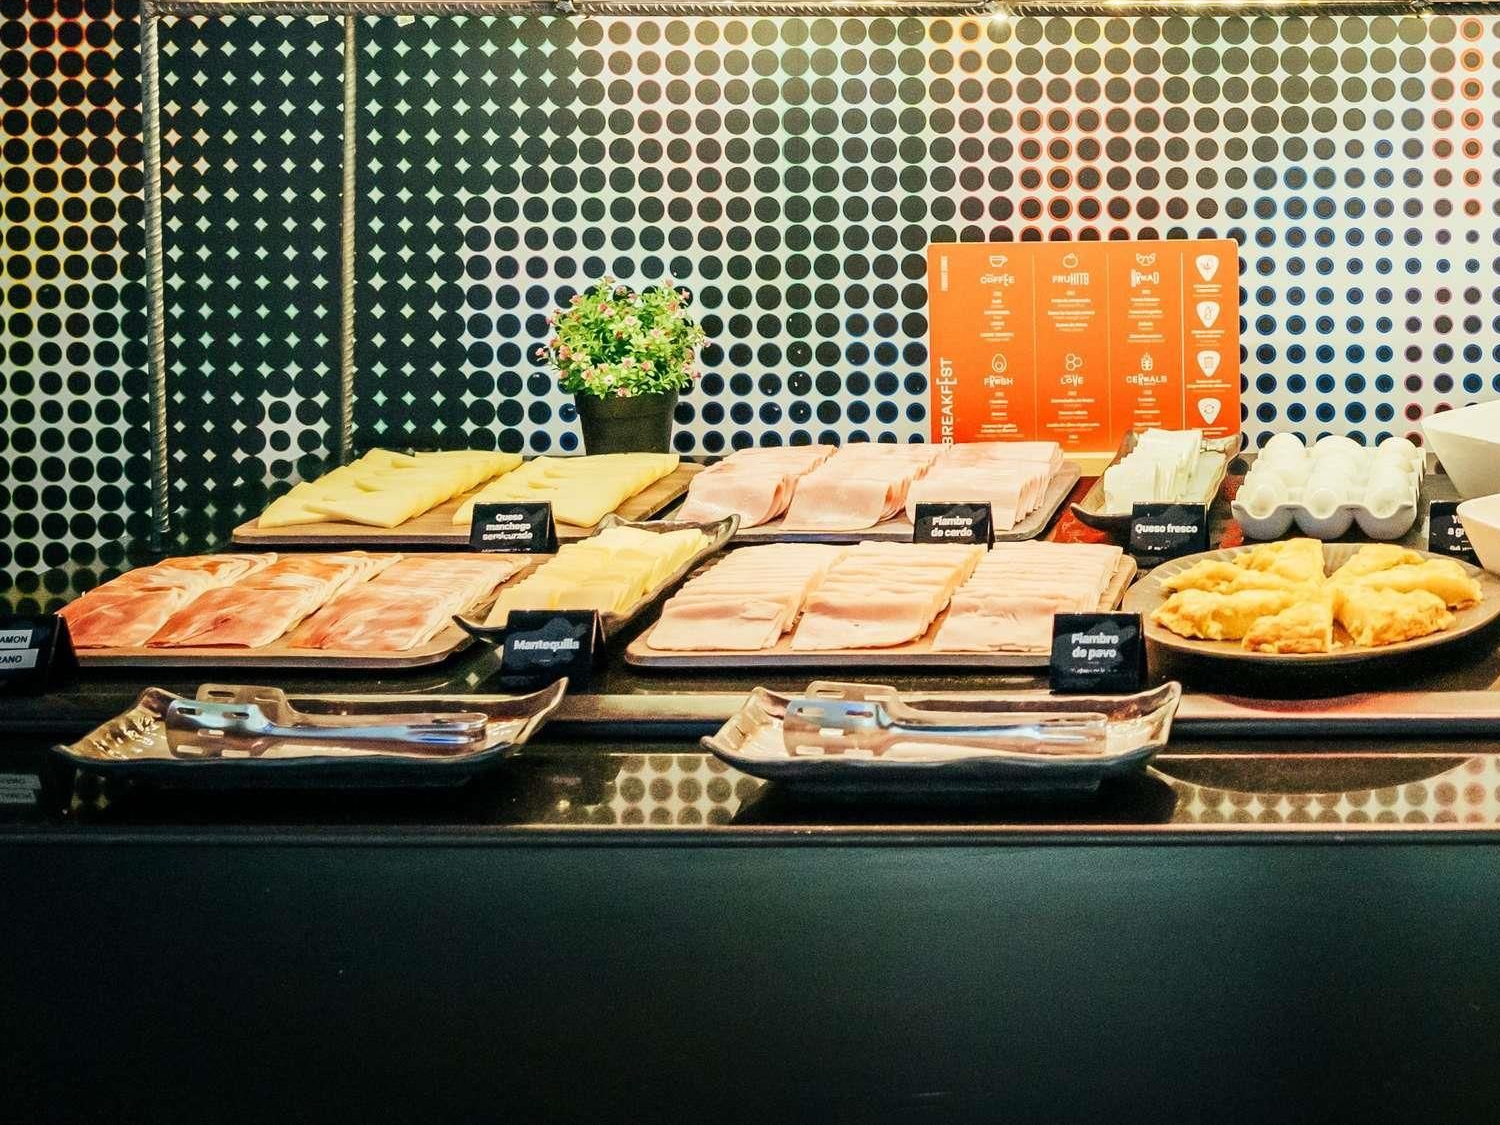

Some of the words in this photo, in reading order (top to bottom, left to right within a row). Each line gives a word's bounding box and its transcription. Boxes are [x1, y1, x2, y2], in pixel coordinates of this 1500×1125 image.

[1060, 375, 1084, 387] LOVE
[932, 516, 973, 526] Fiambre
[931, 527, 944, 537] de
[945, 527, 973, 537] cerdo
[1135, 523, 1166, 534] Queso
[1167, 523, 1198, 534] fresco
[1071, 631, 1119, 644] Fiambre
[513, 637, 580, 652] Mantequilla
[1071, 645, 1087, 658] de
[1088, 649, 1117, 661] pavo
